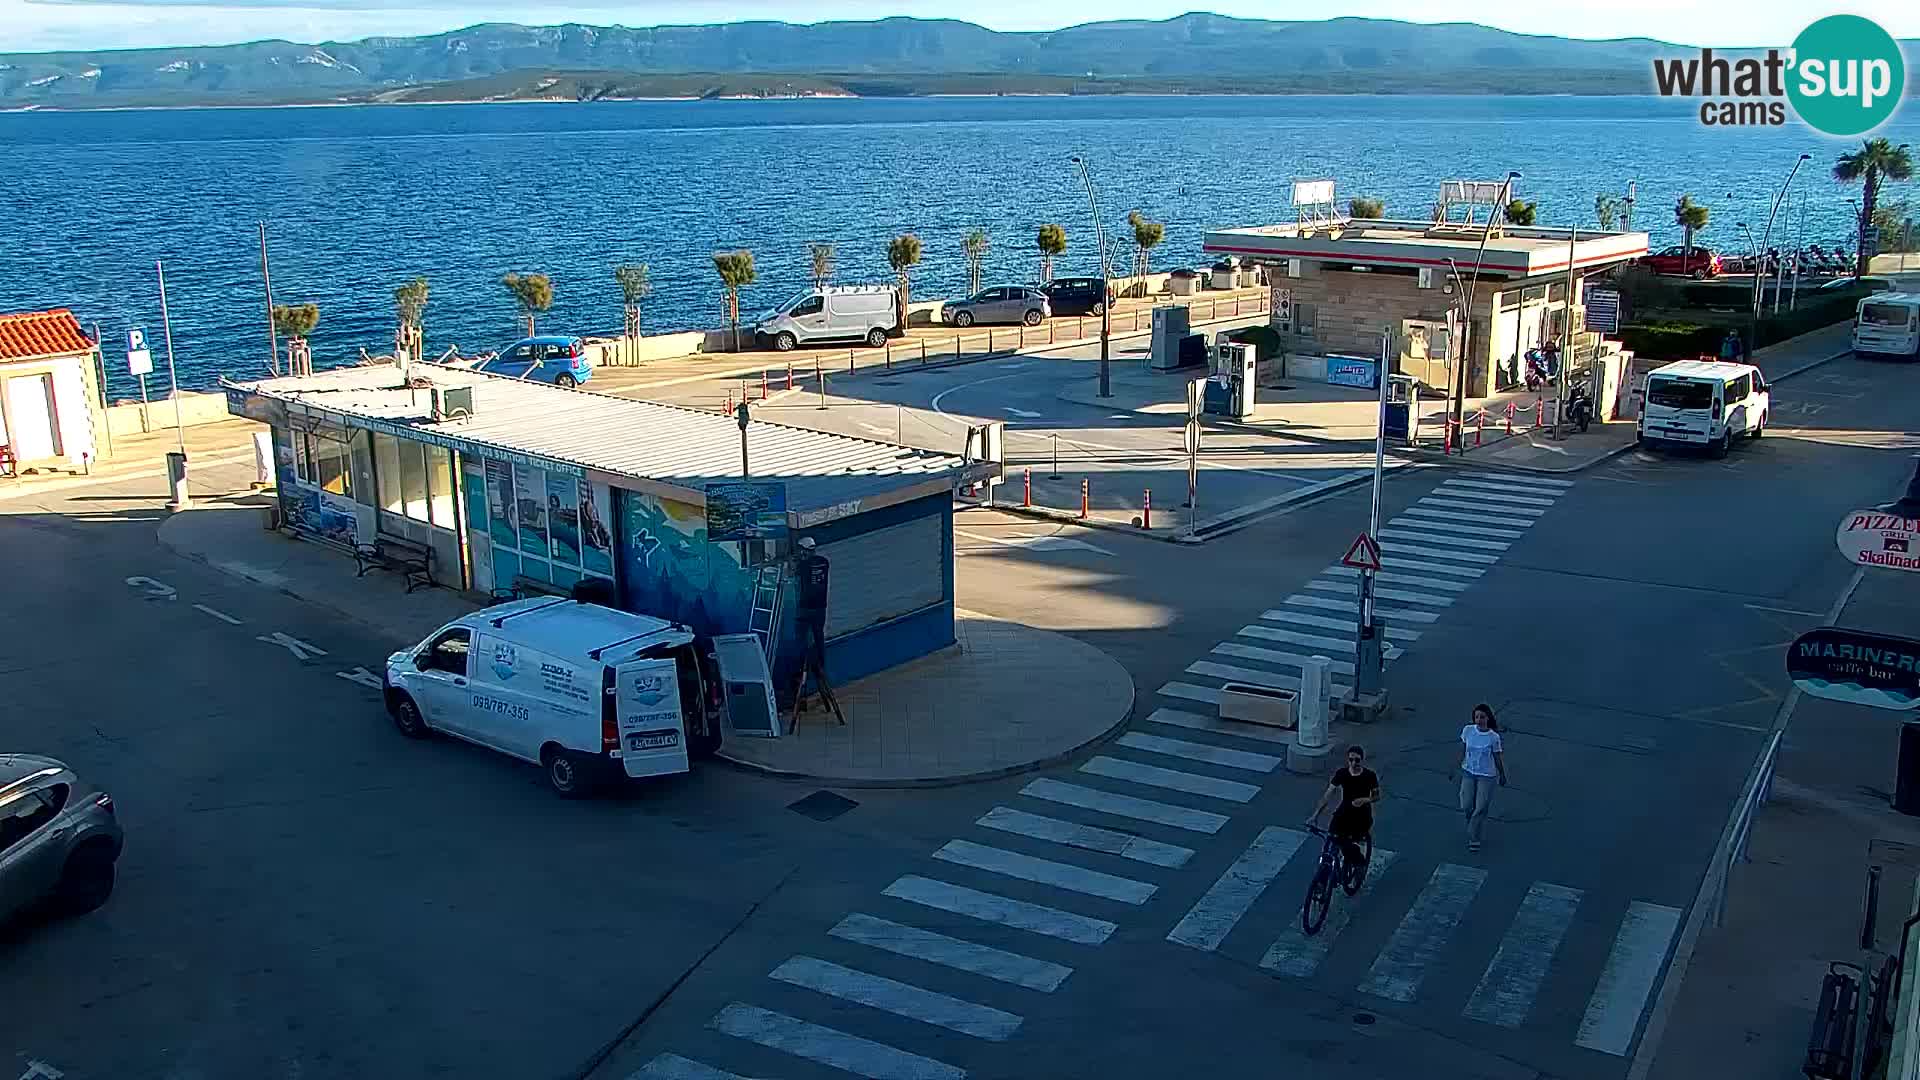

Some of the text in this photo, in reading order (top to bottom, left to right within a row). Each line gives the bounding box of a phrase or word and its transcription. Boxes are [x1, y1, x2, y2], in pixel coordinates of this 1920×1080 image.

[129, 330, 144, 350] P
[479, 445, 494, 457] BUS
[495, 449, 526, 465] STATION
[527, 456, 555, 470] TICKET
[556, 463, 583, 477] OFFICE
[1868, 666, 1897, 681] bar
[473, 695, 529, 720] 098/787-356
